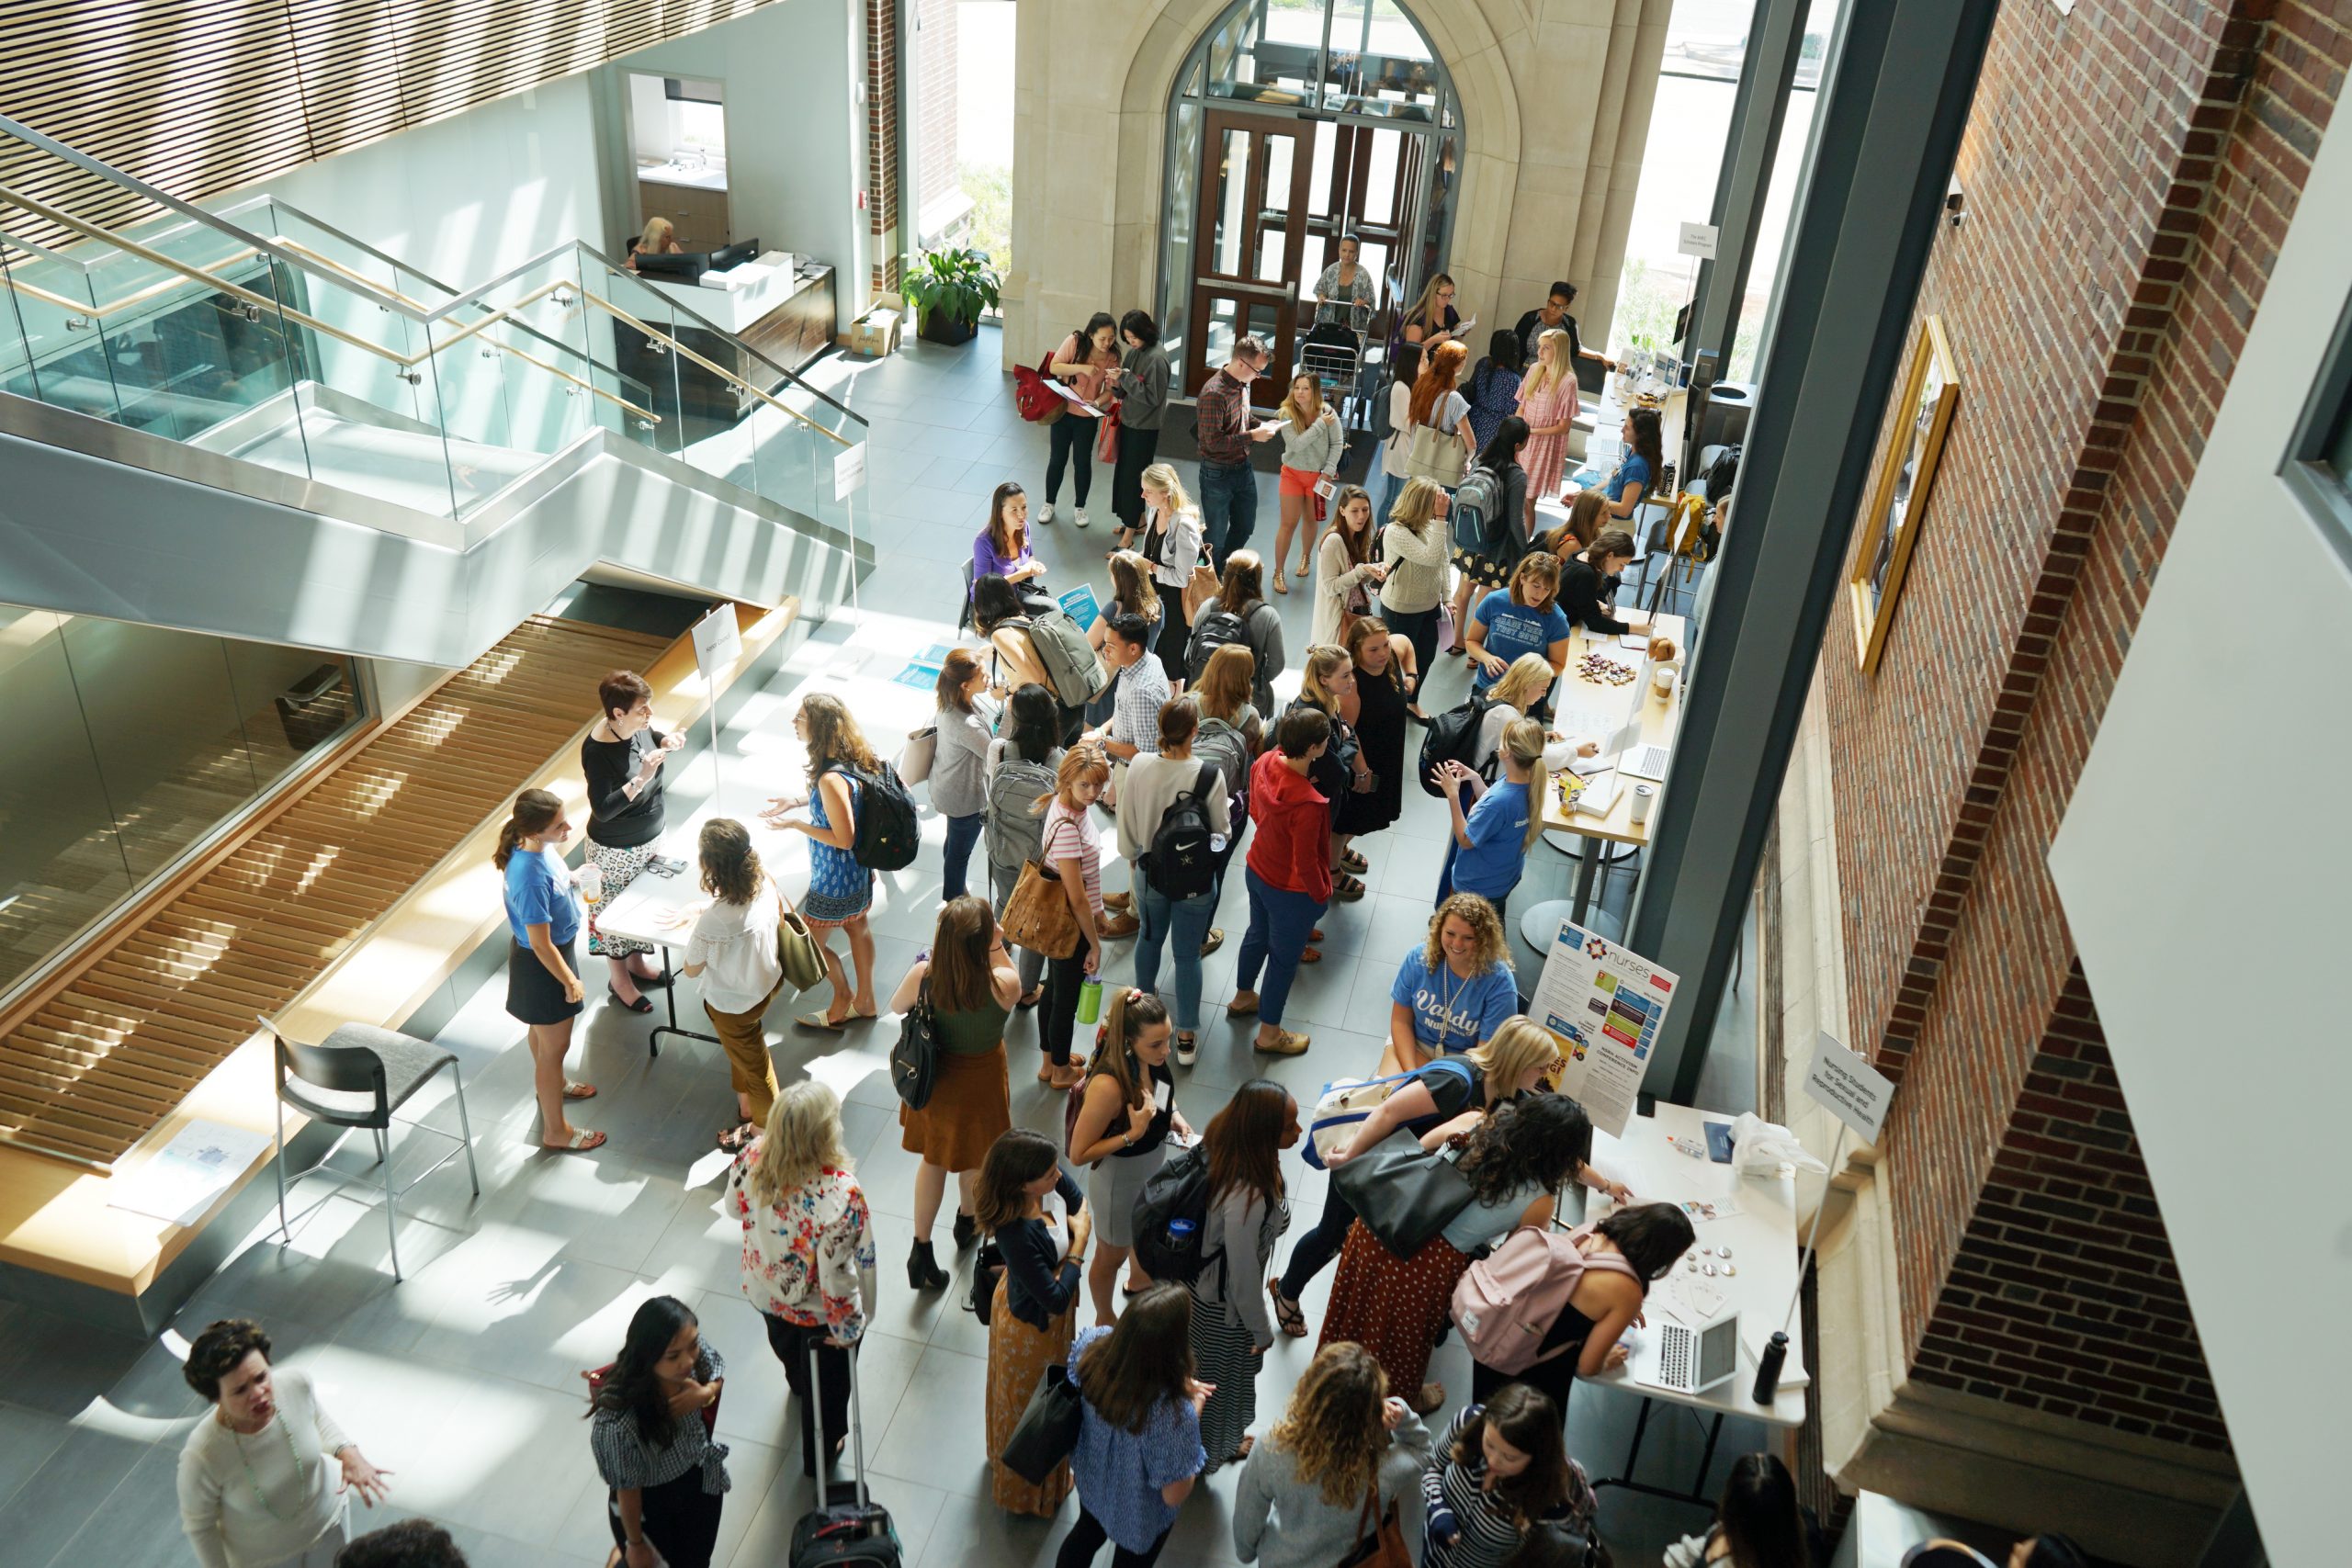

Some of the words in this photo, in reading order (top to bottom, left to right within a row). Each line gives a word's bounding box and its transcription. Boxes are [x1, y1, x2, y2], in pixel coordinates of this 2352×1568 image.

[1608, 951, 1650, 979] nurses
[1597, 1049, 1626, 1069] CONFERENCE
[1823, 1056, 1849, 1080] Nursing
[1849, 1074, 1877, 1101] Students
[1812, 1073, 1854, 1111] Reproductive
[1852, 1107, 1875, 1127] Health
[1824, 1070, 1835, 1081] for
[1834, 1077, 1856, 1099] Sexual
[1855, 1094, 1870, 1109] and
